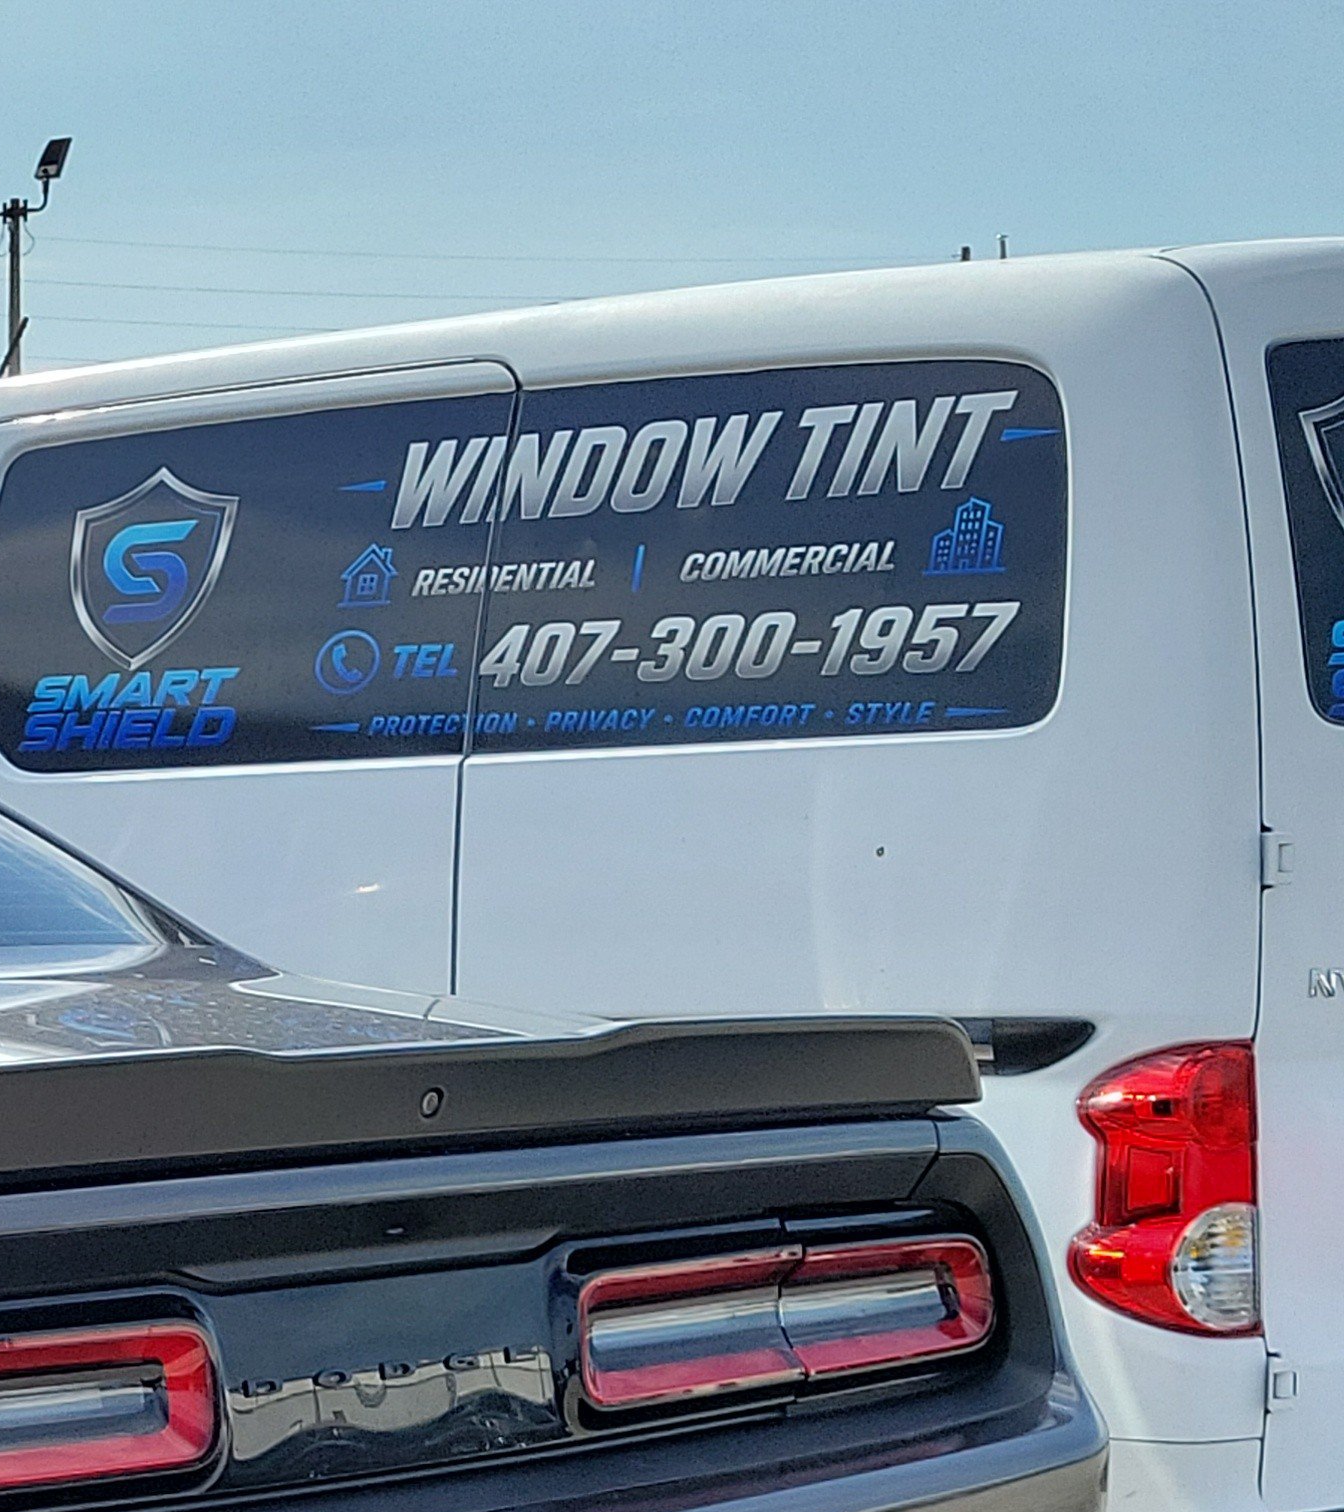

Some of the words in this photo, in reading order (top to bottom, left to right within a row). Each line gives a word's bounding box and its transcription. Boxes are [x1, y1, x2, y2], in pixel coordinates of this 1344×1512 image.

[390, 411, 783, 530] WINDOW
[785, 390, 1019, 501] TINT
[412, 558, 597, 598] RESIDENTIAL
[679, 540, 896, 582] COMMERCIAL
[392, 641, 459, 680] TEL
[478, 601, 1021, 689] 407-300-1957
[26, 667, 241, 713] SMART
[17, 706, 239, 753] SHIELD
[368, 711, 519, 738] PROTECTION
[546, 707, 655, 733] PRIVACY
[683, 704, 816, 729] COMFORT
[844, 701, 937, 725] STYLE
